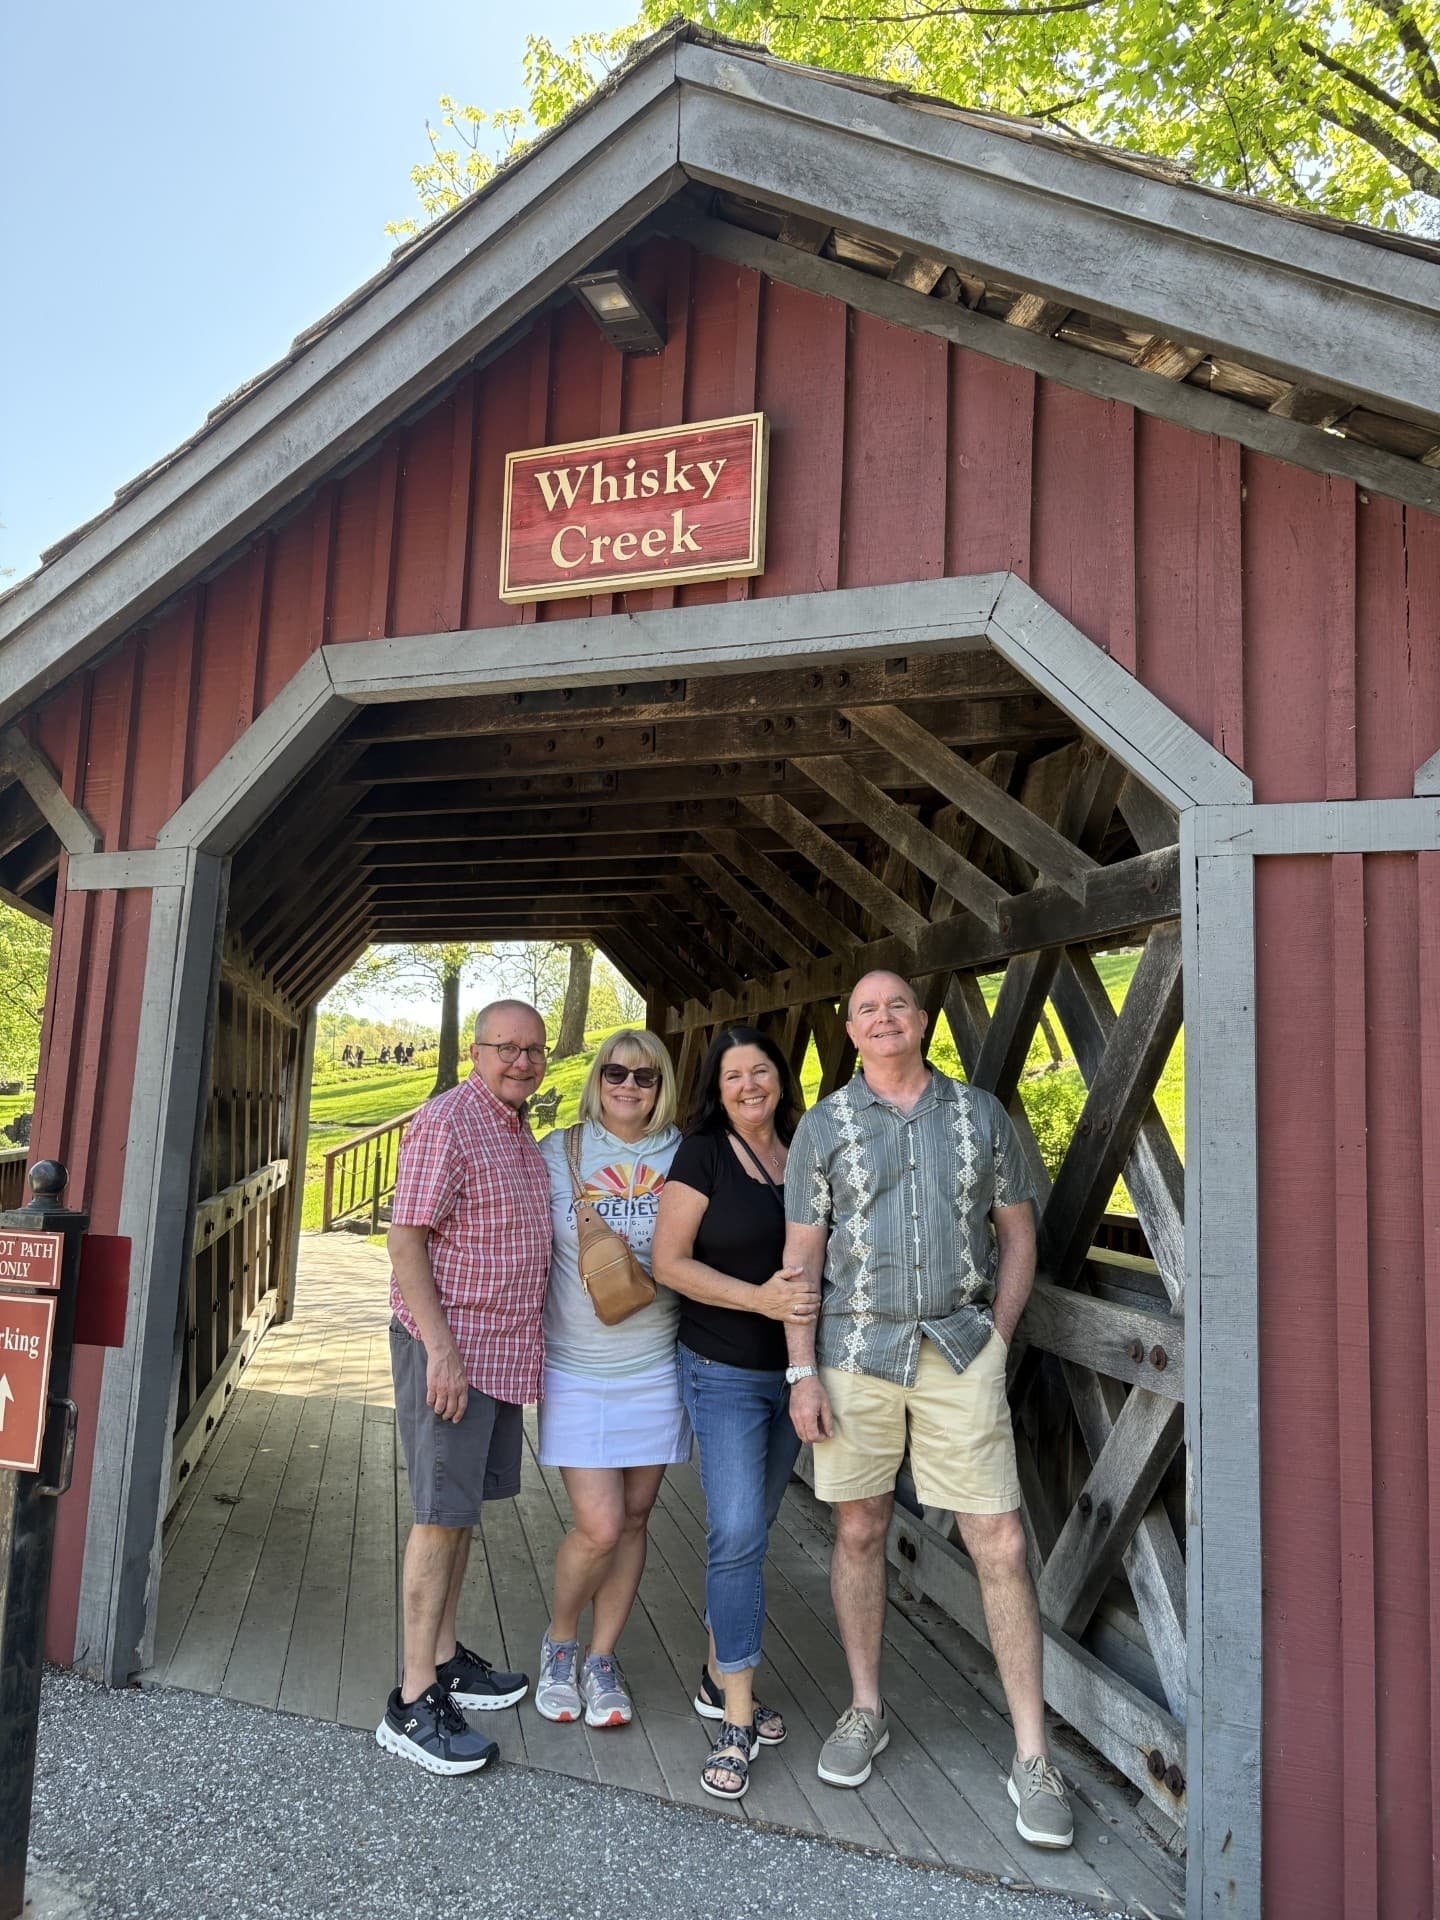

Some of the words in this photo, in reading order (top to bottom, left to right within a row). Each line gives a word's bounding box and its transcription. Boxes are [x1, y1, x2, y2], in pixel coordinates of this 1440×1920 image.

[534, 449, 728, 512] Whisky
[551, 509, 702, 569] Creek
[568, 1201, 658, 1216] OEBEL
[20, 1241, 54, 1259] PATH
[0, 1260, 31, 1278] ONLY
